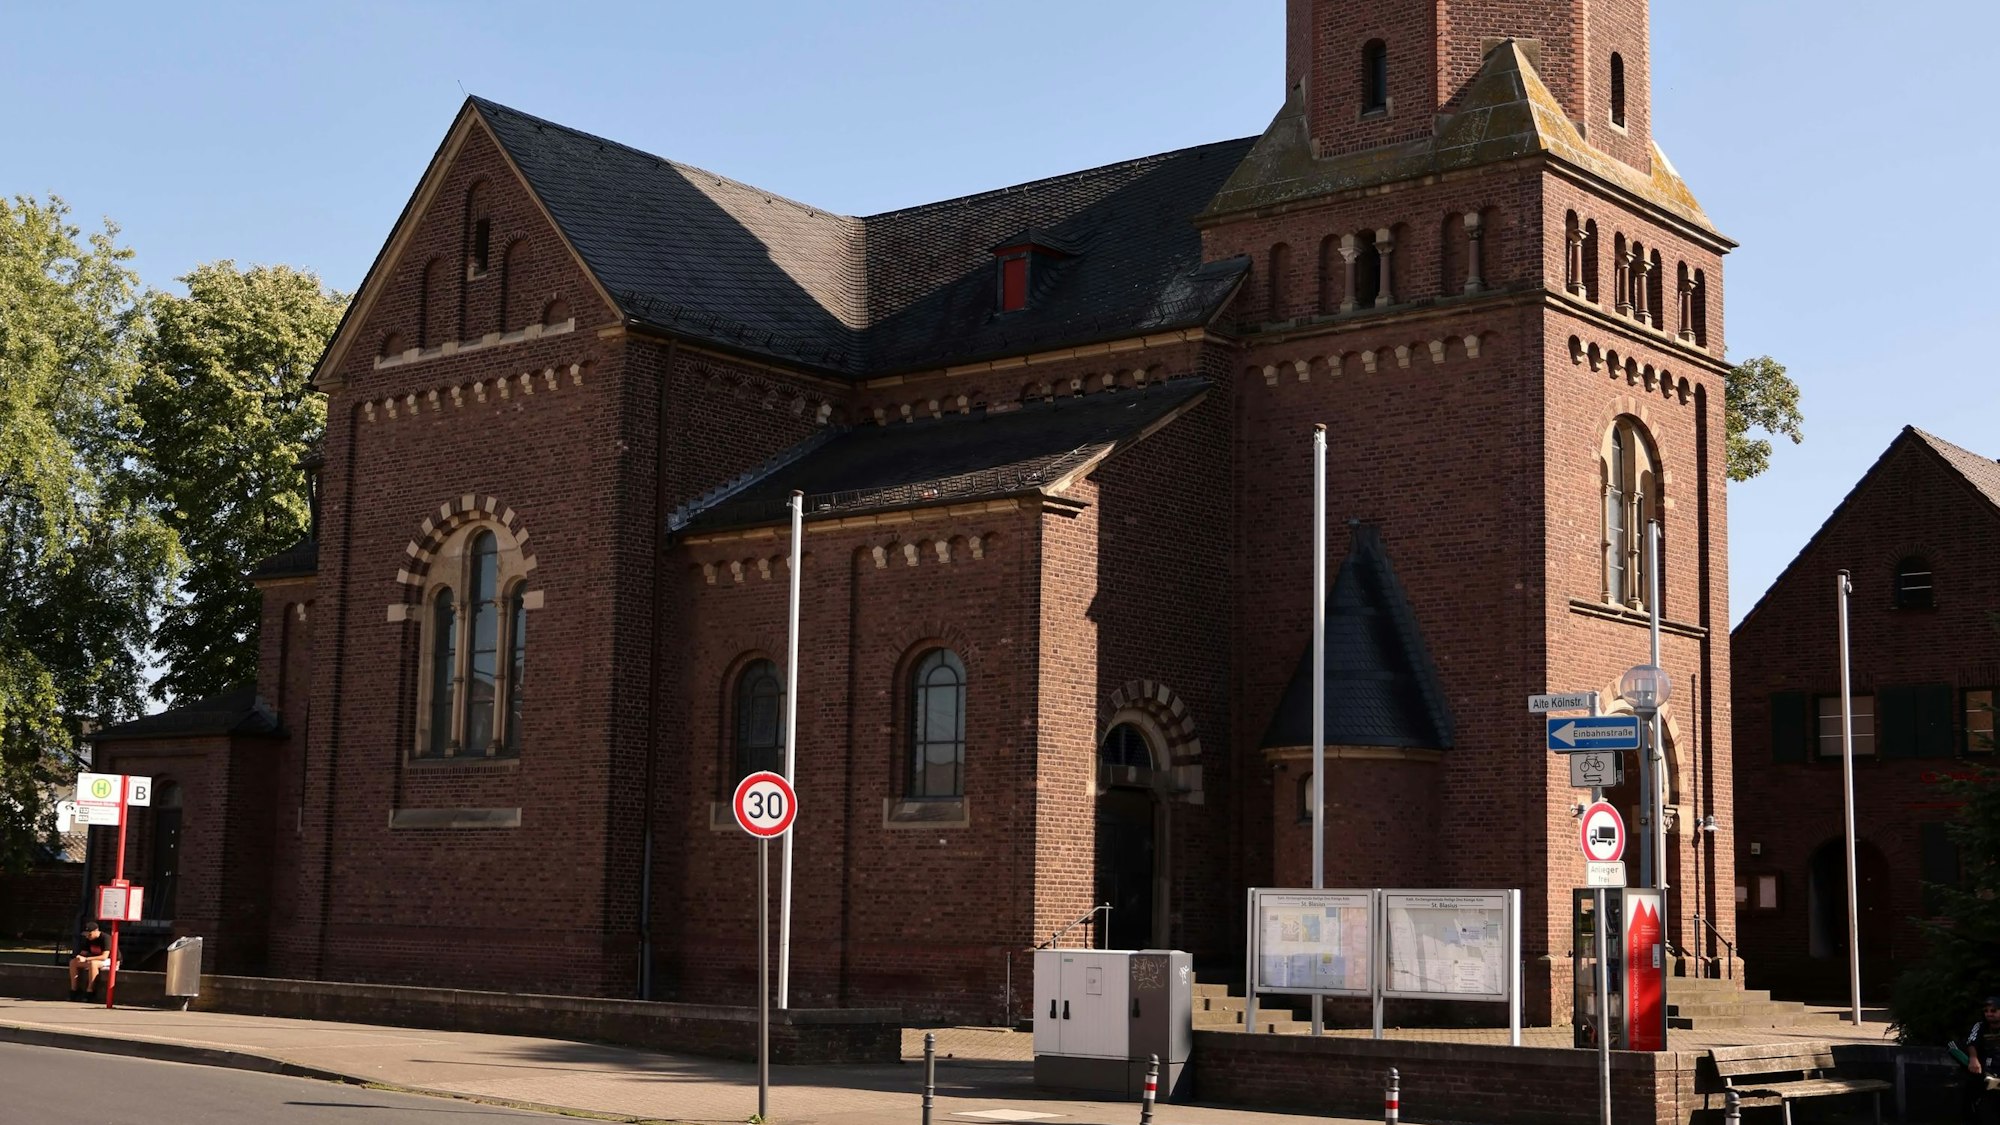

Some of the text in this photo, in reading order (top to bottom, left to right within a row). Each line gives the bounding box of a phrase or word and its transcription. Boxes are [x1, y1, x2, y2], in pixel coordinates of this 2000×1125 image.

[1533, 697, 1583, 709] Alte Kölnstr.
[1573, 729, 1633, 738] Einbahnstraße
[97, 782, 107, 795] H
[135, 786, 147, 800] B
[748, 791, 783, 819] 30
[1591, 866, 1619, 875] Anlieger
